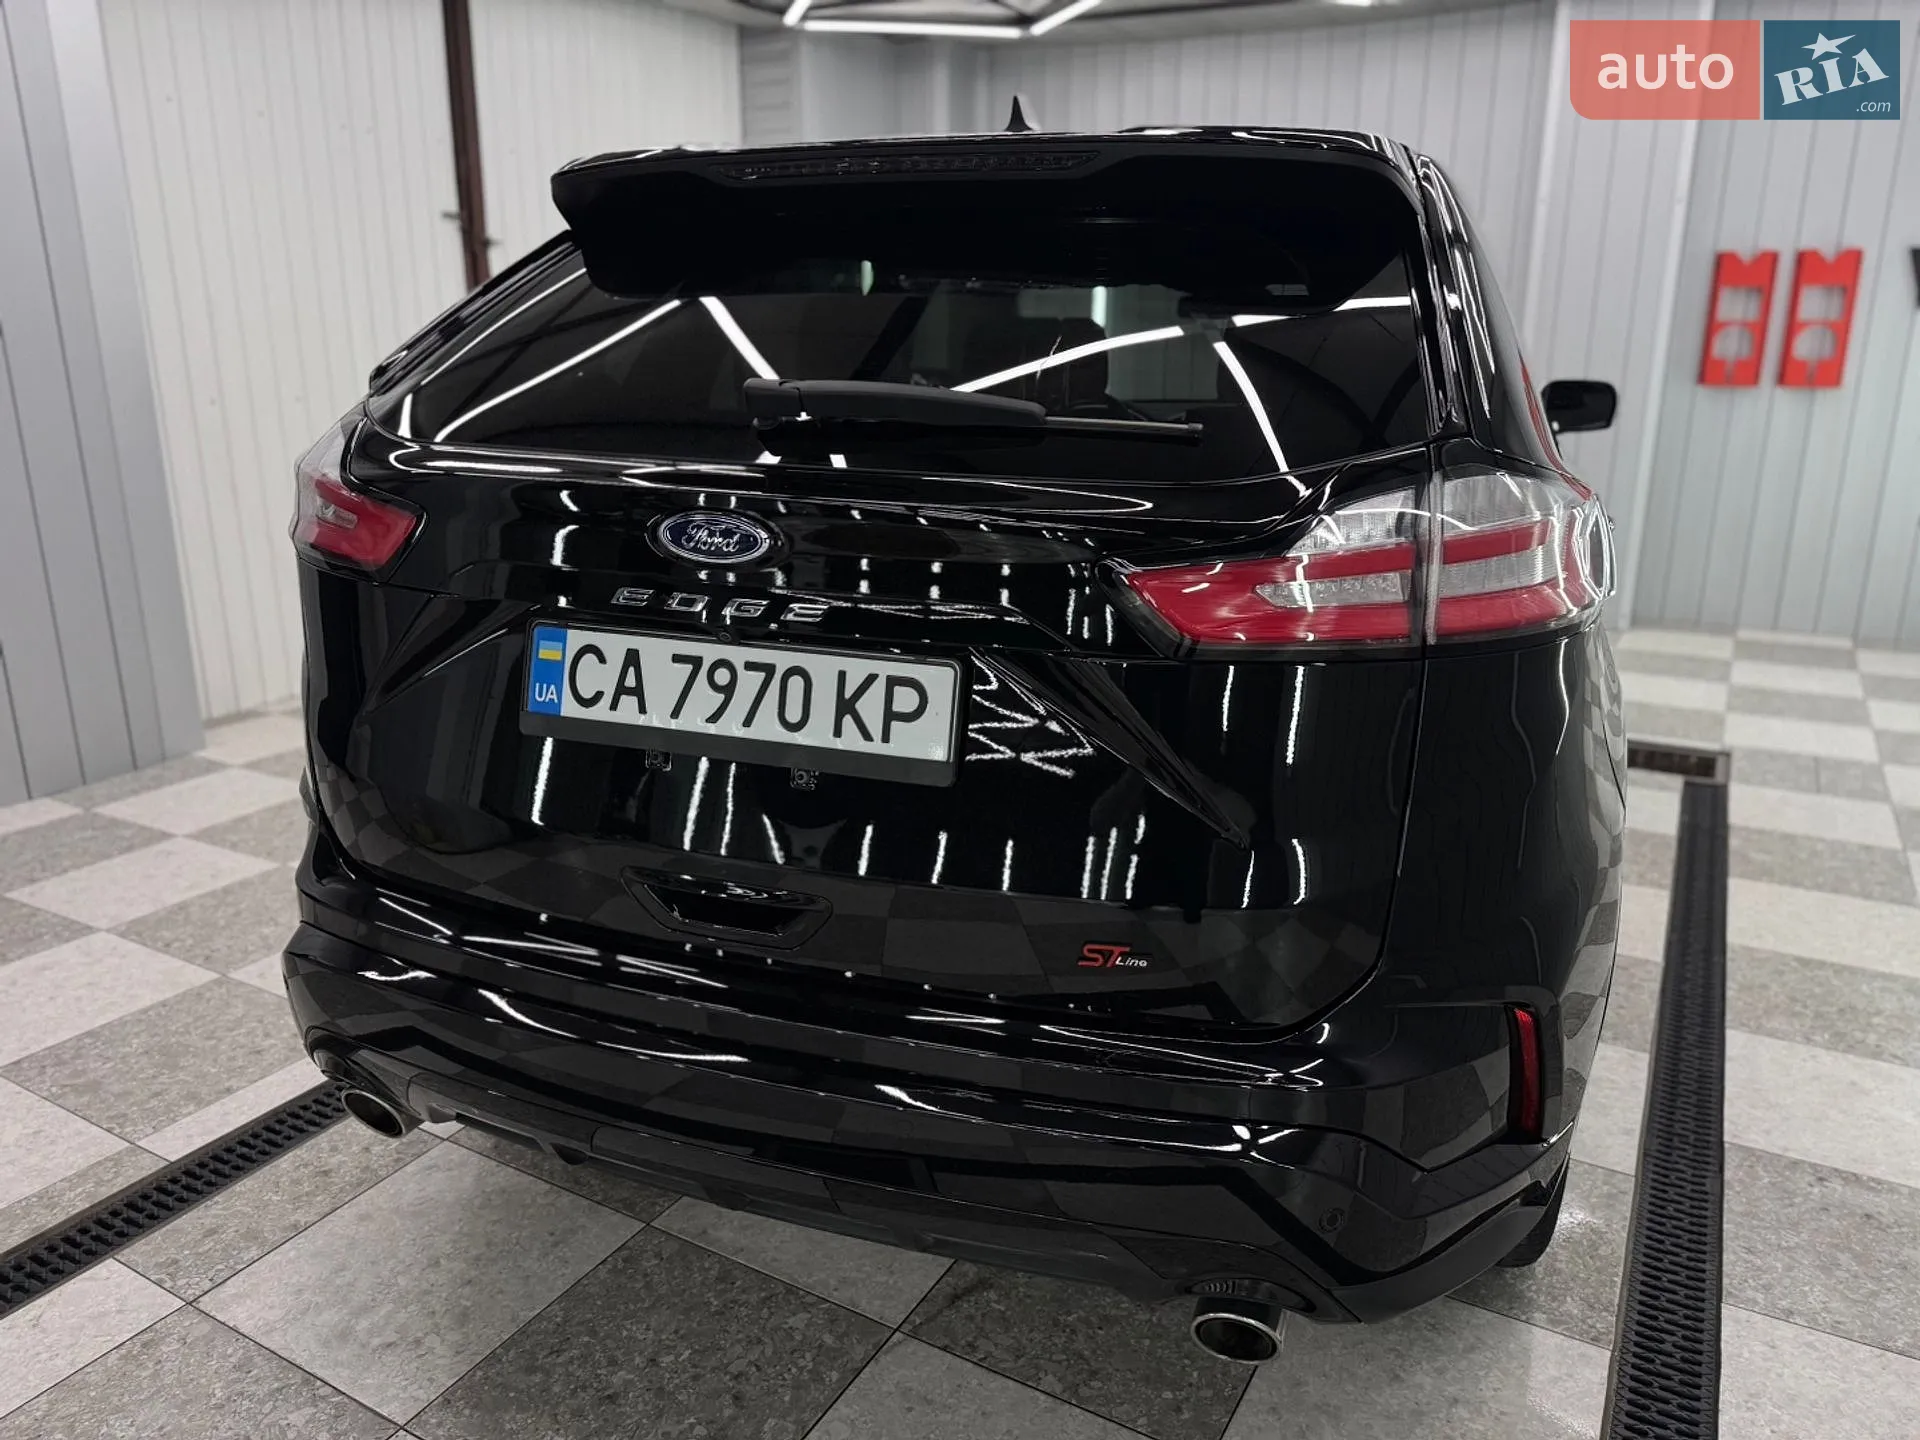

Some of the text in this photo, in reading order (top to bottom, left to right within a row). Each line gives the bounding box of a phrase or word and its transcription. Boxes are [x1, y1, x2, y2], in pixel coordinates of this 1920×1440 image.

[681, 520, 741, 552] Ford
[610, 586, 831, 622] EDGE
[535, 682, 559, 704] UA
[568, 643, 929, 744] CA 7970 KP
